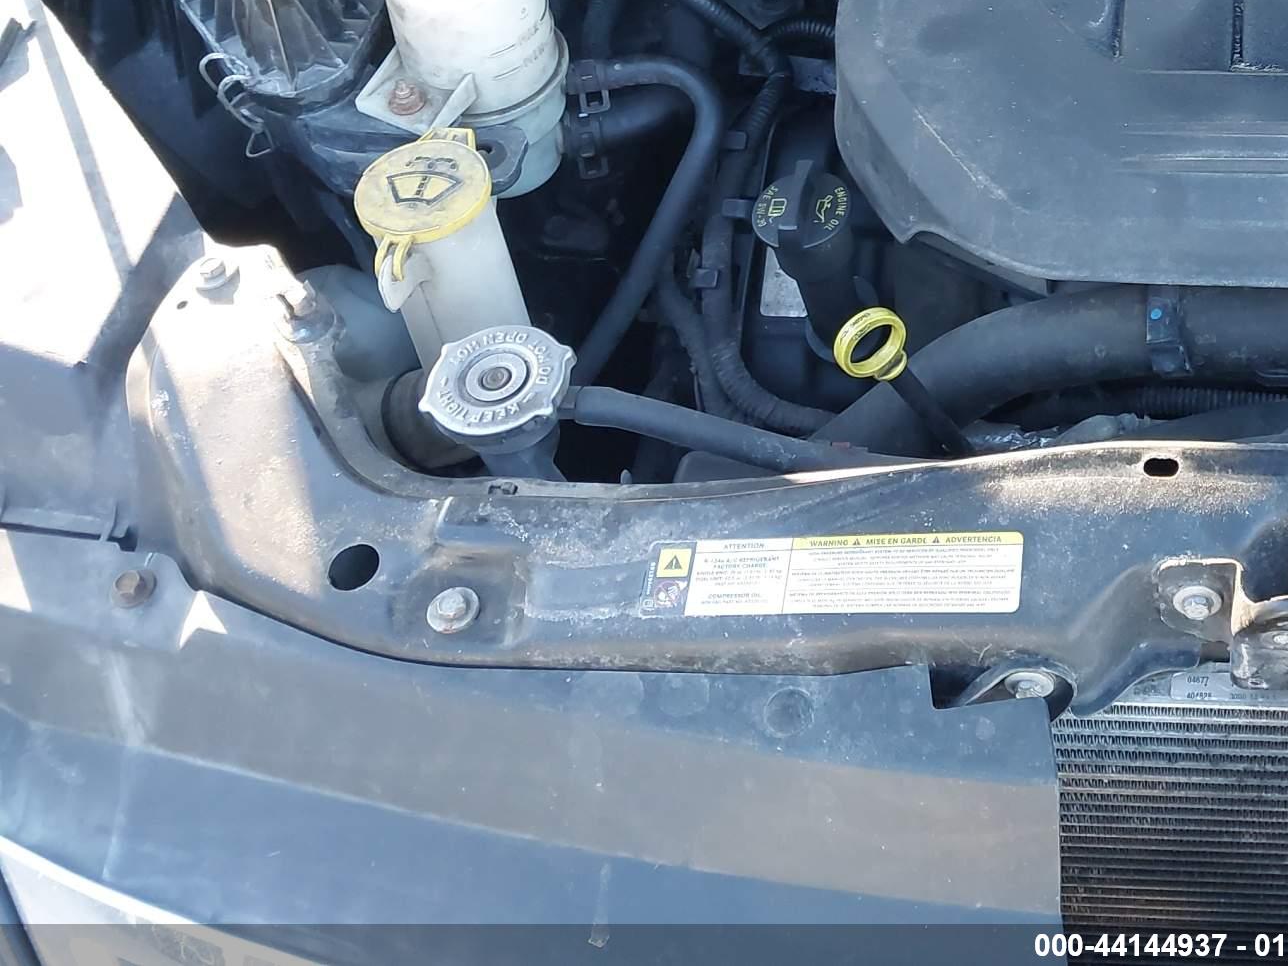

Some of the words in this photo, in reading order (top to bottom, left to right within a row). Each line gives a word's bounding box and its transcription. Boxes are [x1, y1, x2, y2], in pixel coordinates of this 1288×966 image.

[833, 186, 848, 216] ENGINE
[823, 218, 840, 231] OIL
[483, 329, 529, 346] OPEN
[535, 365, 553, 386] DO
[437, 388, 469, 422] TIGHT
[468, 402, 521, 424] KEEP
[723, 542, 765, 550] ATTENTION
[810, 539, 850, 547] WARNING
[866, 537, 888, 545] MISE
[945, 535, 1003, 544] ADVERTENCIA
